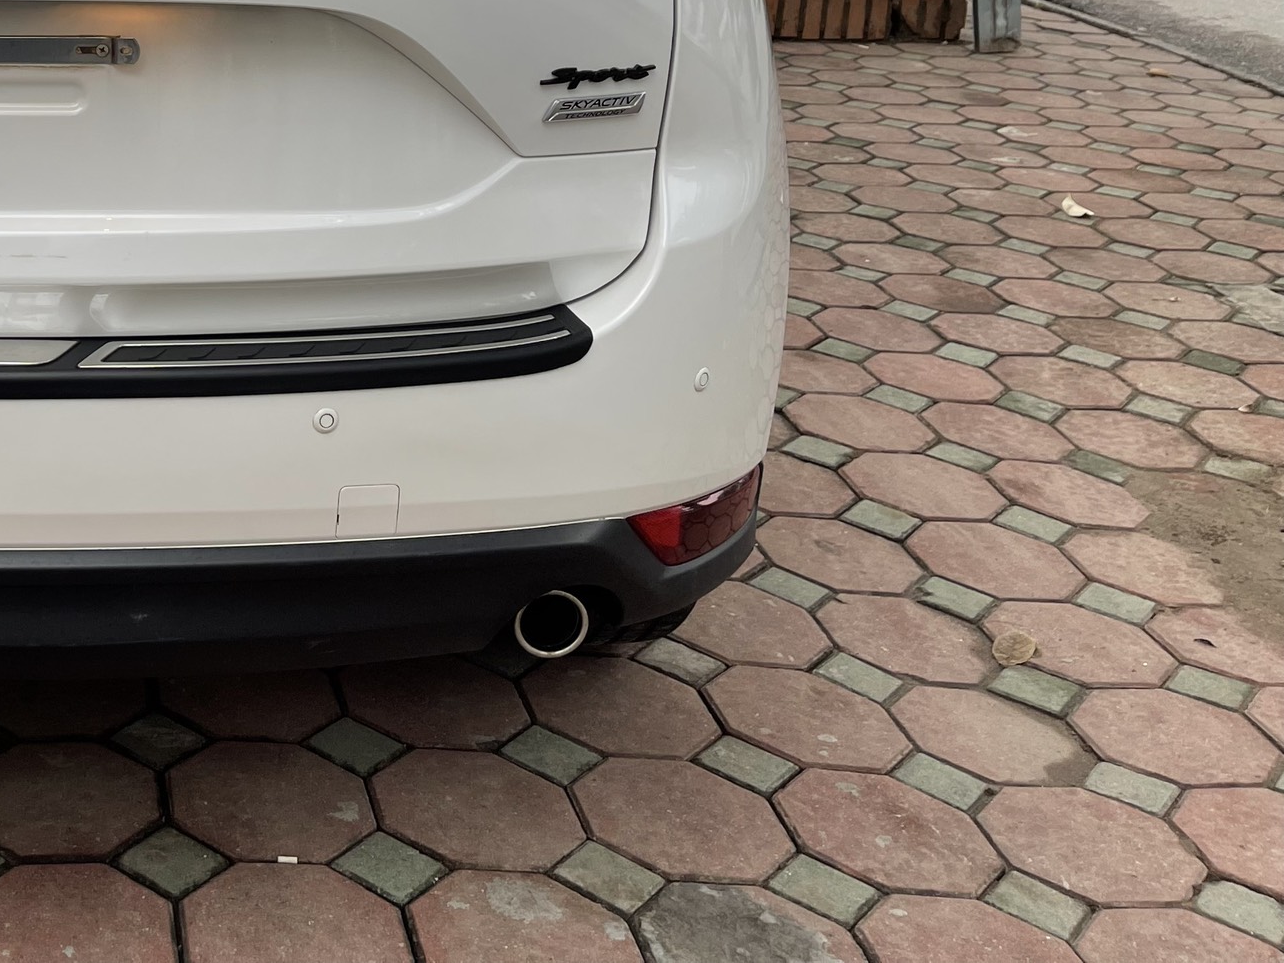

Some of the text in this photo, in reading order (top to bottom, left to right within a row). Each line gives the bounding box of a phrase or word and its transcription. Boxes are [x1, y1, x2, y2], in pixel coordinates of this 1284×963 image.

[539, 63, 657, 90] Sport
[559, 95, 637, 111] SKYACTIV
[564, 108, 627, 120] TECHNOLOGY
